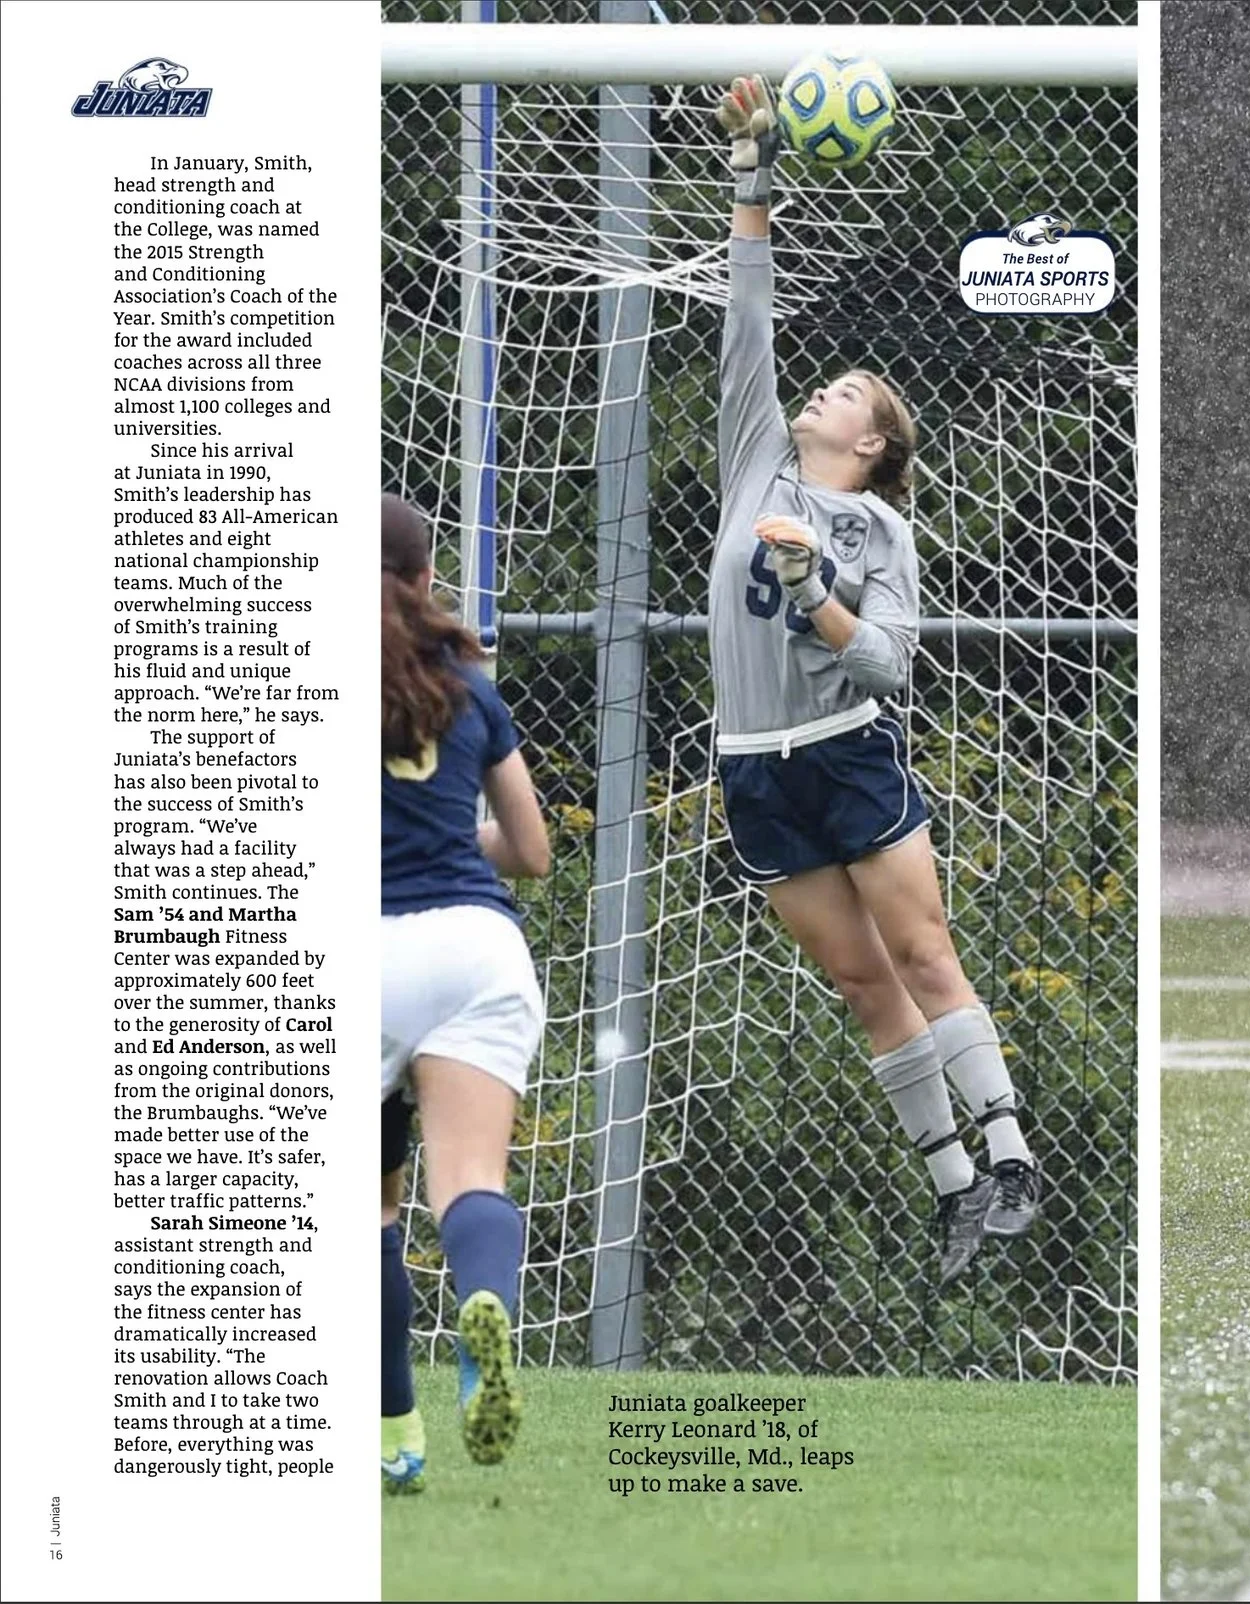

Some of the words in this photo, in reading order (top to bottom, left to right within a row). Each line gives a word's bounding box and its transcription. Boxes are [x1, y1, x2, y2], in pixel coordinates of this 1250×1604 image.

[150, 156, 169, 171] In
[173, 156, 249, 175] January,
[254, 154, 312, 174] Smith,
[113, 198, 226, 219] conditioning
[229, 198, 281, 215] coach
[285, 200, 303, 215] at
[113, 243, 143, 260] the
[146, 245, 184, 260] 2015
[188, 243, 265, 264] Strength
[113, 287, 226, 304] Association’s
[230, 287, 283, 304] Coach
[287, 287, 305, 304] of
[308, 287, 338, 304] the
[114, 331, 139, 348] for
[142, 331, 172, 348] the
[176, 331, 232, 348] award
[237, 331, 313, 348] included
[113, 377, 163, 392] NCAA
[167, 375, 246, 392] divisions
[251, 375, 294, 392] from
[113, 420, 222, 436] universities.
[114, 465, 131, 480] at
[135, 464, 202, 480] Juniata
[206, 464, 225, 480] in
[229, 465, 271, 483] 1990,
[113, 508, 194, 528] produced
[198, 509, 217, 524] 83
[221, 508, 339, 524] All-American
[114, 552, 189, 568] national
[193, 552, 319, 572] championship
[113, 596, 243, 616] overwhelming
[246, 600, 312, 613] success
[113, 644, 199, 661] programs
[203, 640, 218, 657] is
[223, 644, 234, 657] a
[238, 640, 290, 657] result
[294, 640, 312, 657] of
[114, 684, 200, 705] approach.
[204, 684, 261, 701] “We’re
[266, 684, 292, 701] far
[296, 684, 340, 701] from
[149, 728, 183, 745] The
[187, 730, 254, 749] support
[258, 728, 276, 745] of
[114, 773, 146, 790] has
[150, 773, 186, 790] also
[190, 773, 233, 790] been
[236, 773, 297, 794] pivotal
[301, 775, 319, 790] to
[113, 821, 194, 838] program.
[199, 817, 258, 834] “We’ve
[113, 861, 150, 878] that
[154, 865, 191, 878] was
[195, 865, 206, 878] a
[210, 863, 247, 882] step
[251, 861, 316, 881] ahead,”
[113, 907, 155, 922] Sam
[159, 905, 185, 922] ’54
[188, 905, 224, 922] and
[228, 905, 298, 922] Martha
[113, 951, 171, 966] Center
[174, 953, 211, 966] was
[215, 949, 300, 970] expanded
[303, 949, 326, 970] by
[113, 998, 152, 1010] over
[155, 994, 185, 1010] the
[189, 998, 268, 1013] summer,
[273, 994, 336, 1010] thanks
[114, 1038, 148, 1054] and
[152, 1038, 175, 1054] Ed
[178, 1038, 270, 1057] Anderson,
[275, 1042, 295, 1054] as
[298, 1038, 337, 1054] well
[114, 1082, 157, 1098] from
[161, 1082, 191, 1098] the
[195, 1082, 265, 1102] original
[269, 1082, 334, 1101] donors,
[114, 1126, 163, 1143] made
[167, 1126, 220, 1143] better
[223, 1130, 255, 1143] use
[258, 1126, 276, 1143] of
[280, 1126, 309, 1143] the
[113, 1170, 146, 1187] has
[150, 1174, 161, 1187] a
[165, 1170, 218, 1191] larger
[222, 1170, 299, 1191] capacity,
[150, 1214, 204, 1231] Sarah
[208, 1214, 287, 1231] Simeone
[291, 1214, 318, 1234] ’14,
[113, 1258, 226, 1279] conditioning
[229, 1258, 285, 1278] coach,
[113, 1303, 143, 1320] the
[147, 1303, 206, 1320] fitness
[210, 1305, 266, 1320] center
[270, 1303, 302, 1320] has
[114, 1348, 136, 1364] its
[140, 1347, 221, 1368] usability.
[225, 1347, 266, 1364] “The
[113, 1435, 172, 1455] Before,
[177, 1435, 274, 1456] everything
[277, 1439, 314, 1452] was
